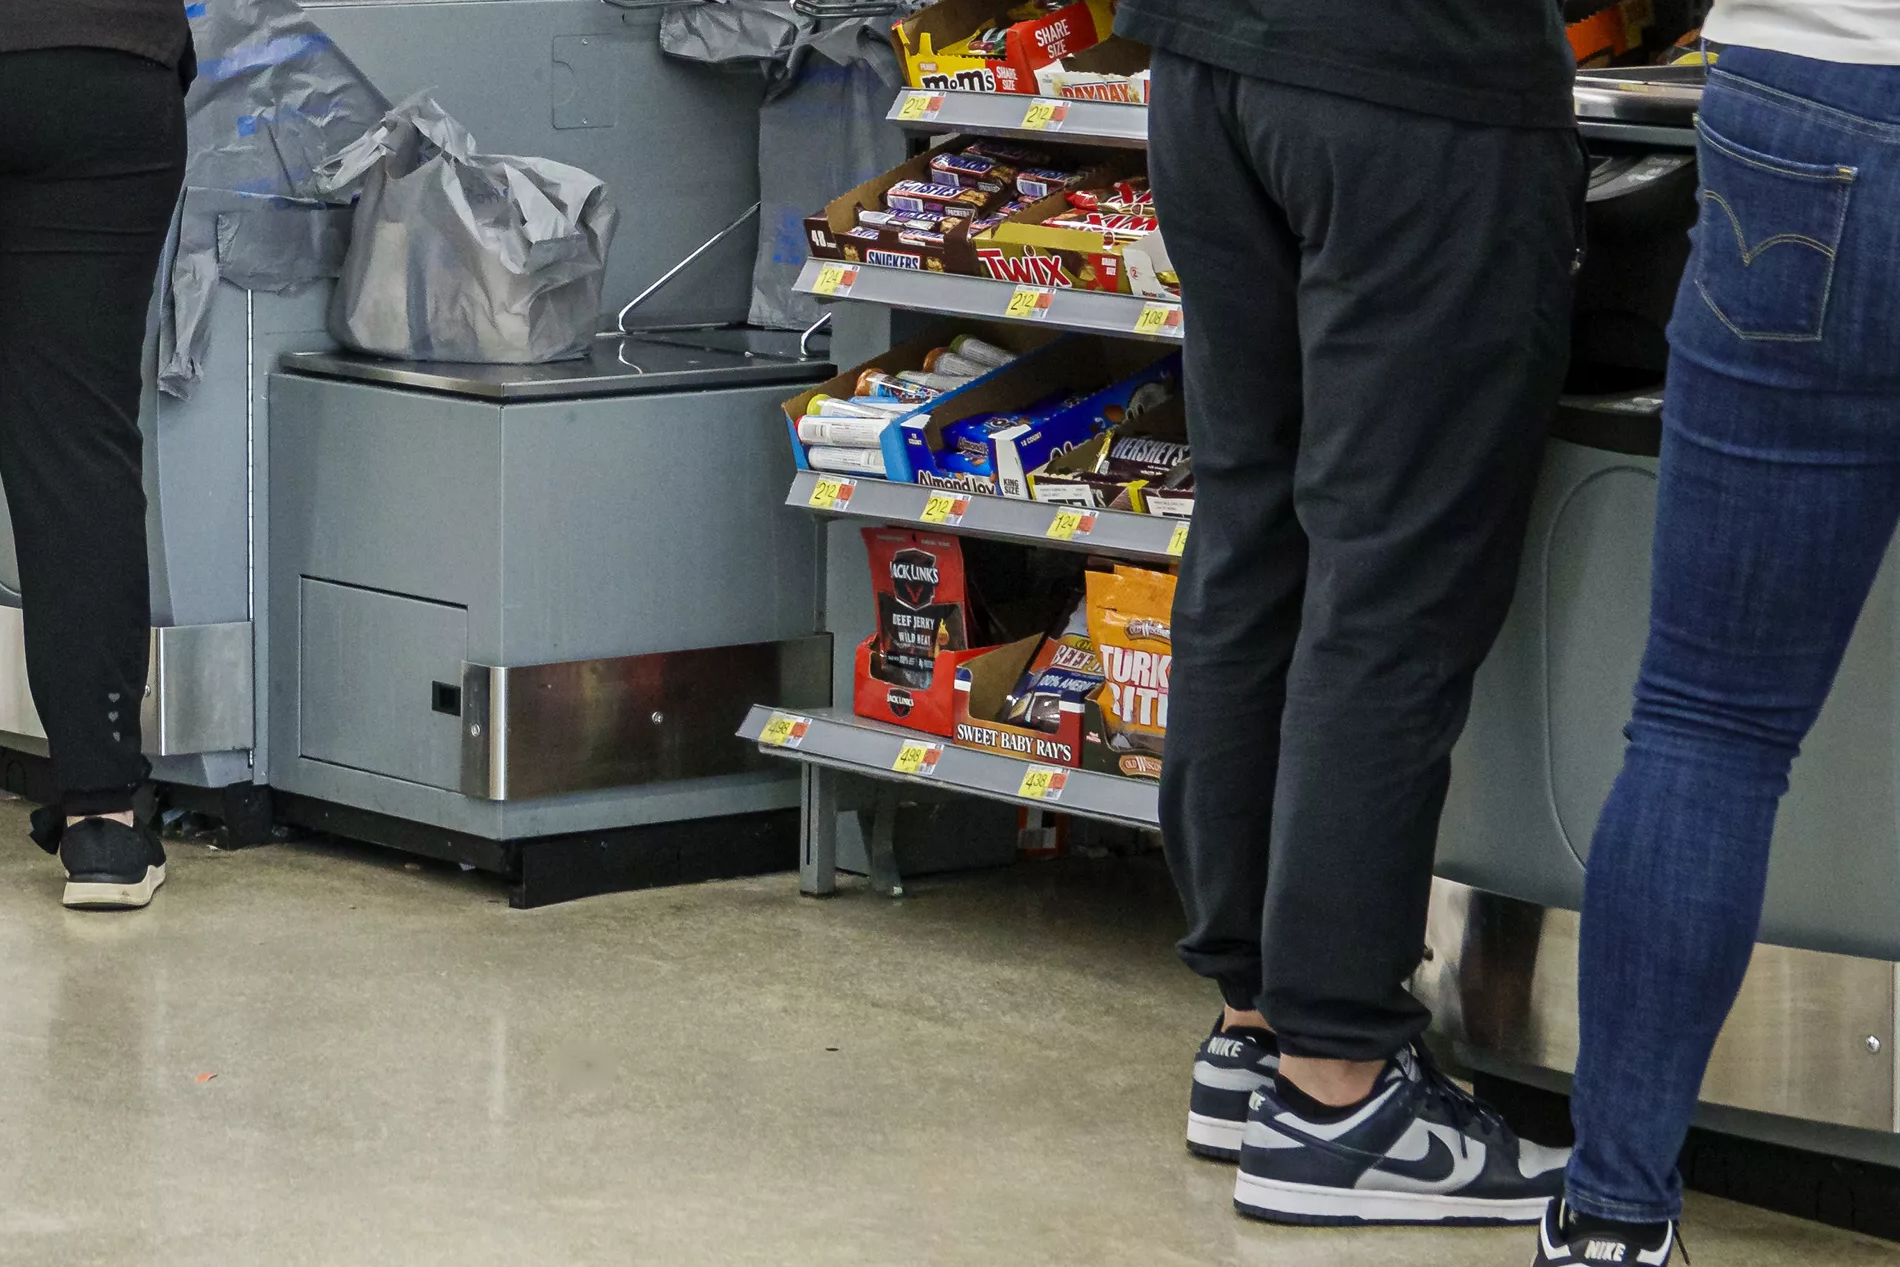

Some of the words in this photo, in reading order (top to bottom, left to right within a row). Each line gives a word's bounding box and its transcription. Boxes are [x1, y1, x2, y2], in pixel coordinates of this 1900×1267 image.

[1034, 18, 1071, 49] SHARE
[1046, 40, 1068, 59] SIZE
[996, 65, 1018, 80] SHARE
[1002, 79, 1017, 91] SIZE
[903, 97, 926, 114] 212
[1027, 106, 1050, 123] 212
[810, 229, 826, 248] 48
[867, 251, 920, 270] SNICKERS
[822, 269, 840, 286] 124
[1011, 290, 1033, 311] 212
[1142, 310, 1161, 325] 108
[917, 470, 972, 492] Almond
[1003, 478, 1019, 488] KING
[813, 482, 834, 500] 212
[1004, 486, 1020, 495] SIZE
[925, 498, 949, 516] 212
[1057, 513, 1077, 531] 124
[889, 561, 911, 583] JACK
[911, 564, 939, 584] LINK'S
[892, 613, 912, 626] BEEF
[913, 615, 935, 630] JERKY
[1051, 644, 1094, 670] BEEF
[1100, 643, 1172, 685] TURK
[957, 722, 999, 747] SWEET
[1001, 731, 1034, 753] BABY
[1035, 739, 1072, 762] RAY'S
[899, 748, 920, 765] 498
[1024, 773, 1047, 790] 438
[1207, 1036, 1244, 1058] NIKE
[1584, 1239, 1626, 1262] NIKE
